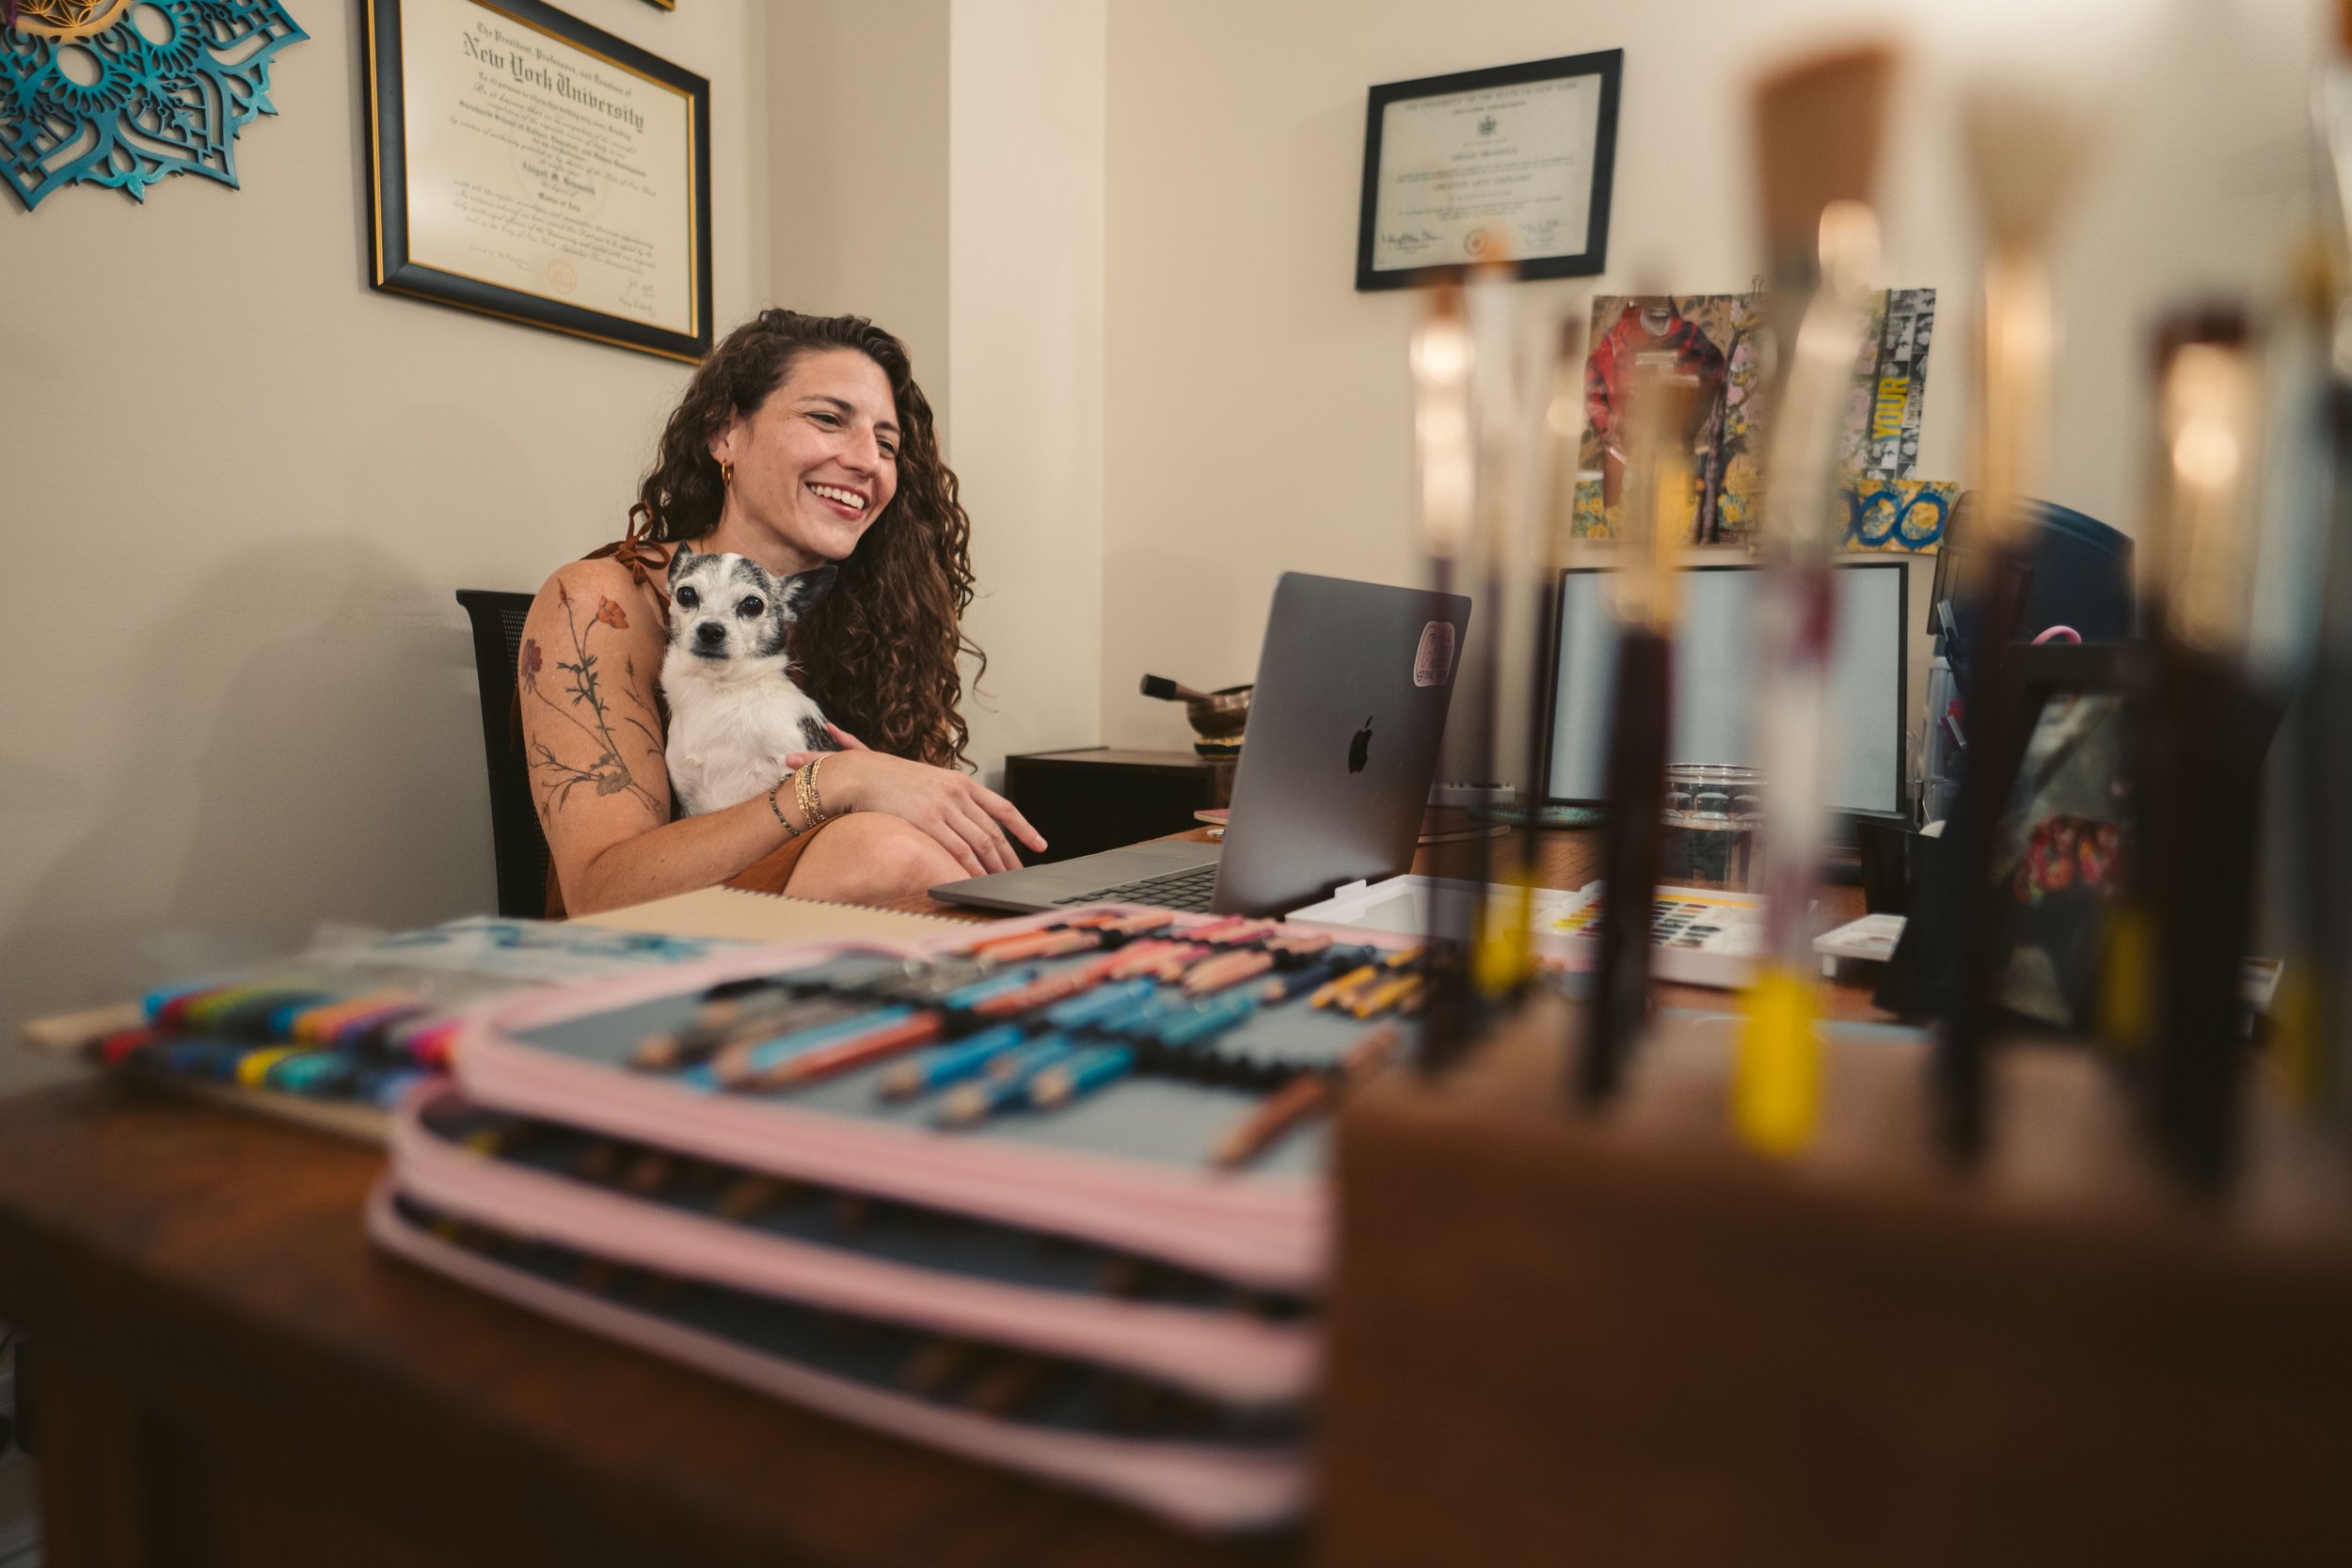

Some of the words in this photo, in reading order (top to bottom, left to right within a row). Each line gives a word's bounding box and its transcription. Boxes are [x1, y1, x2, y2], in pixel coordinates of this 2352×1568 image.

[462, 30, 503, 71] New
[509, 53, 552, 93] York
[556, 77, 644, 133] University
[476, 20, 492, 39] The
[624, 87, 631, 99] of
[1871, 375, 1911, 439] YOUR
